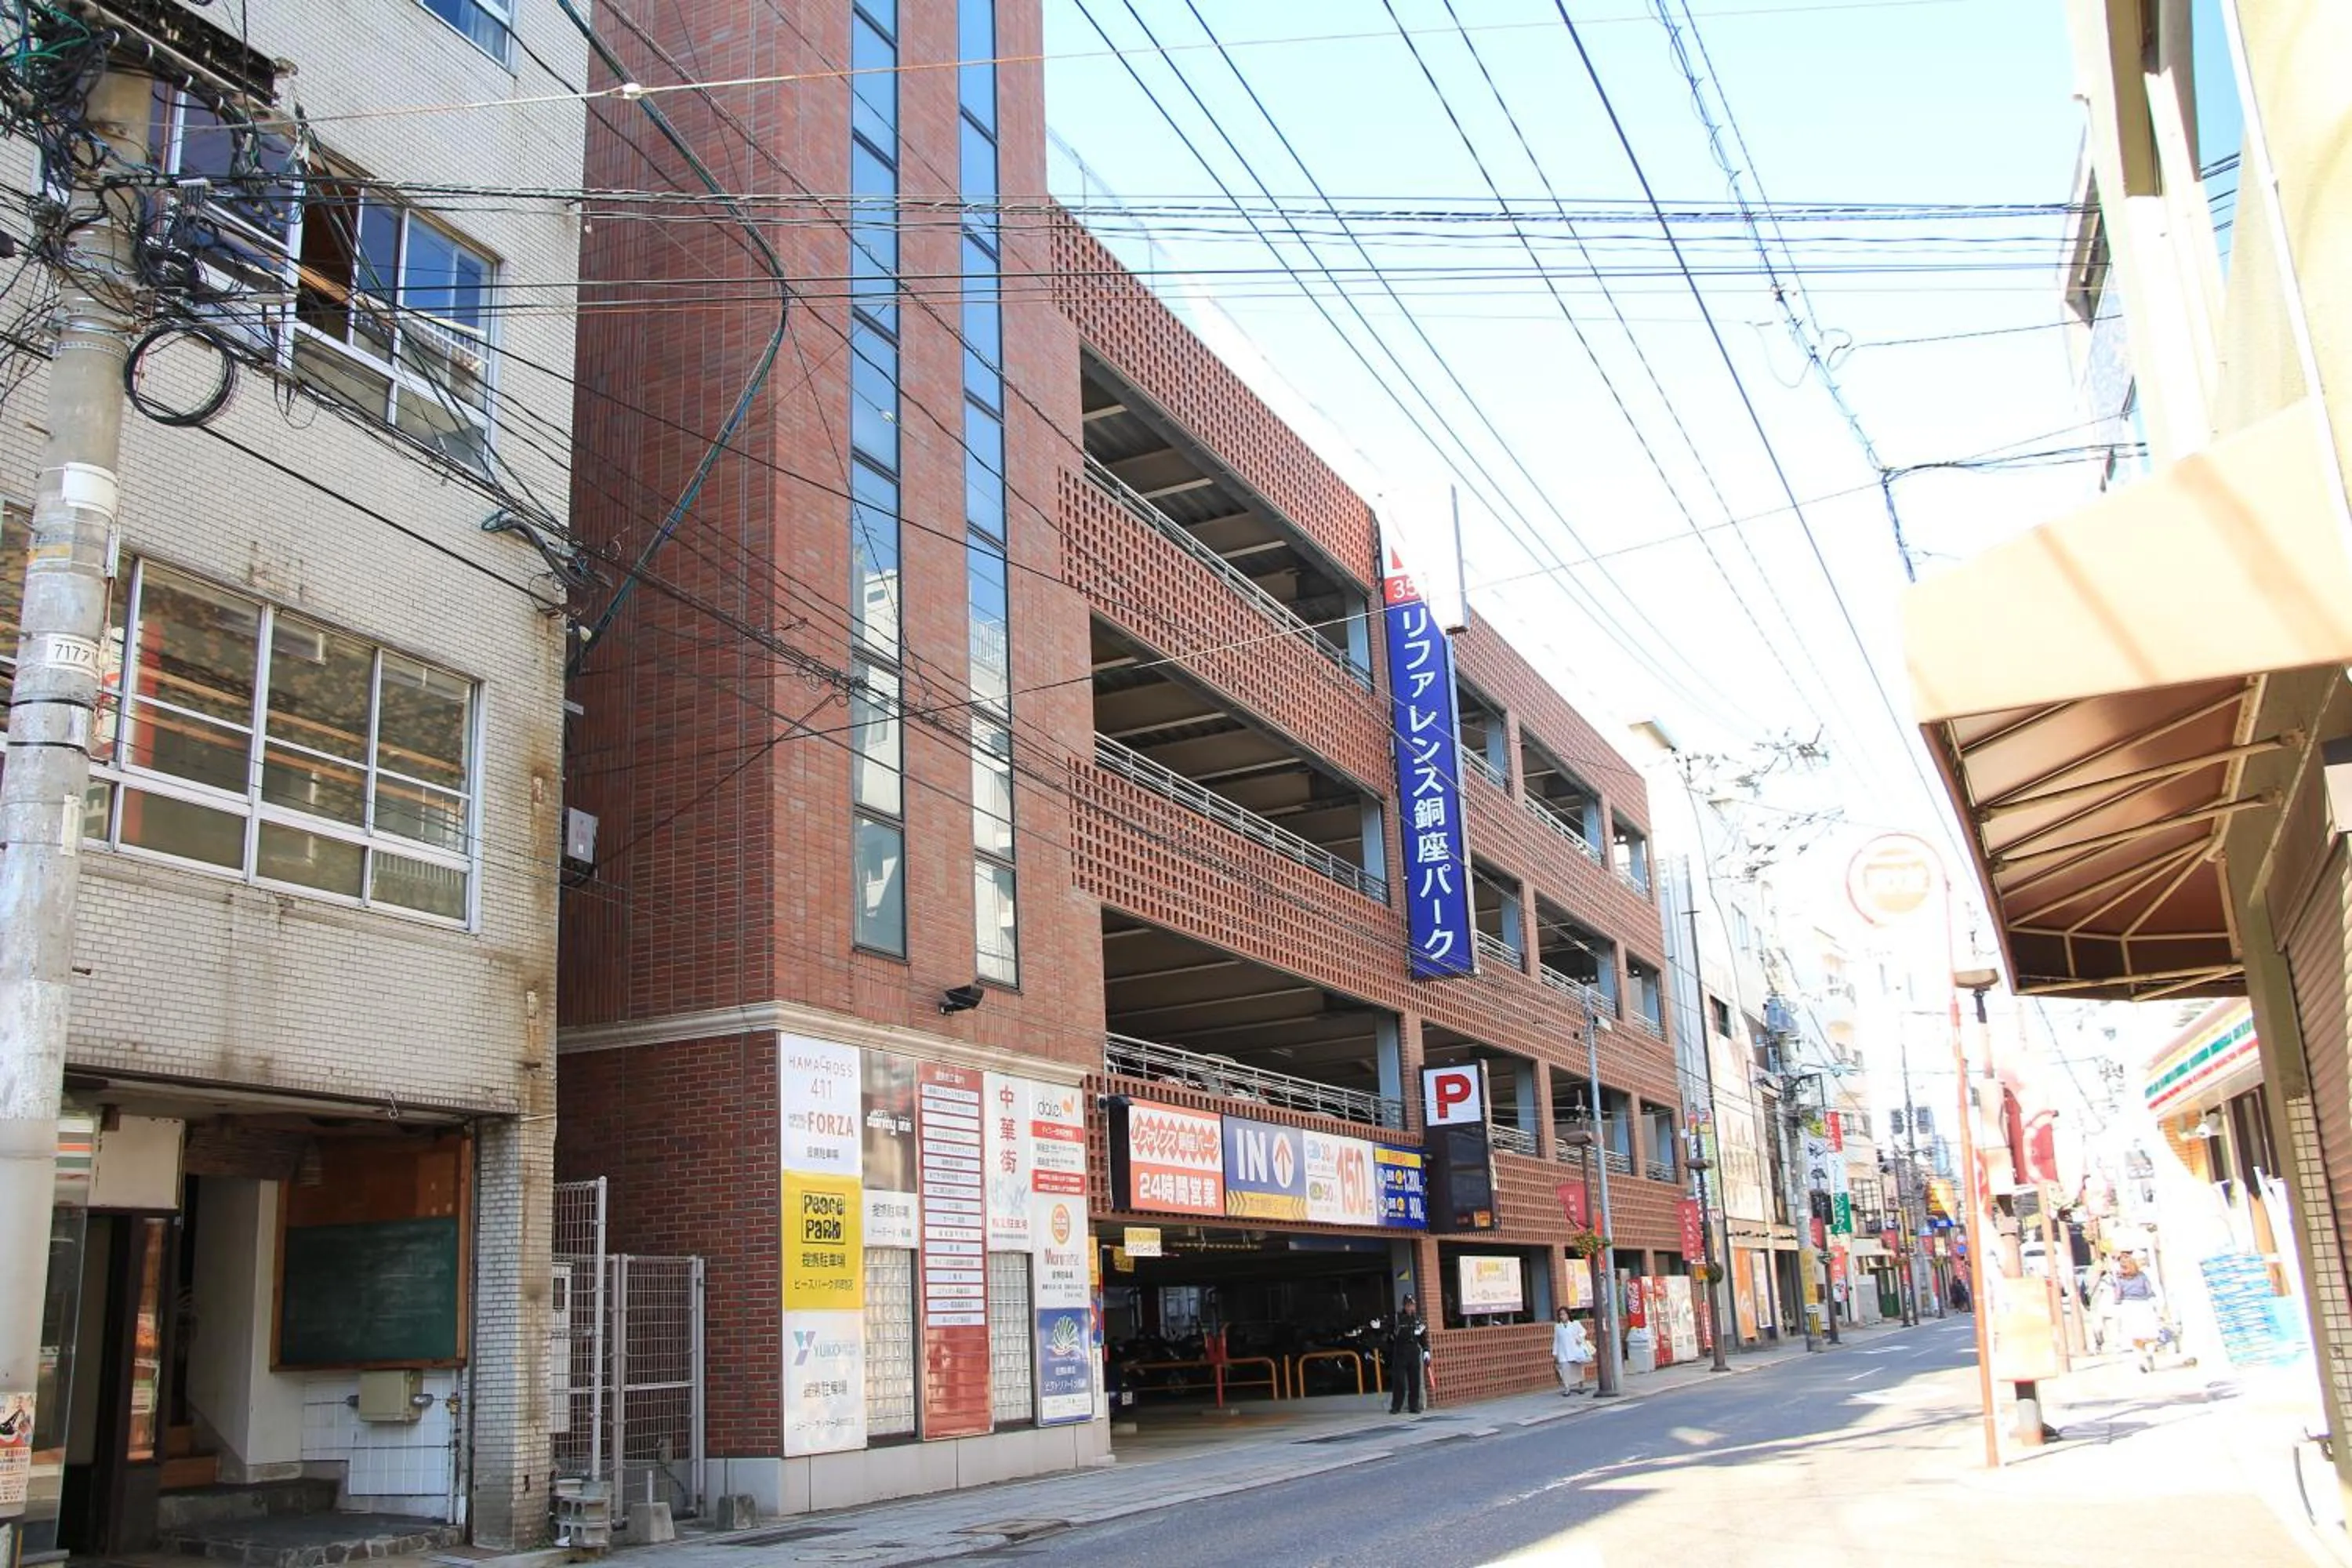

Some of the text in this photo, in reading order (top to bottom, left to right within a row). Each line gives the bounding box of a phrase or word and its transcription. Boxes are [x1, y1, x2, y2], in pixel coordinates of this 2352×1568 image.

[1401, 607, 1455, 960] リファレンス銅座パーク
[1435, 1074, 1472, 1119] P
[807, 1110, 855, 1138] FORZA
[999, 1083, 1017, 1175] 中華街
[1236, 1127, 1268, 1183] IN
[1138, 1172, 1217, 1208] 24時間営業
